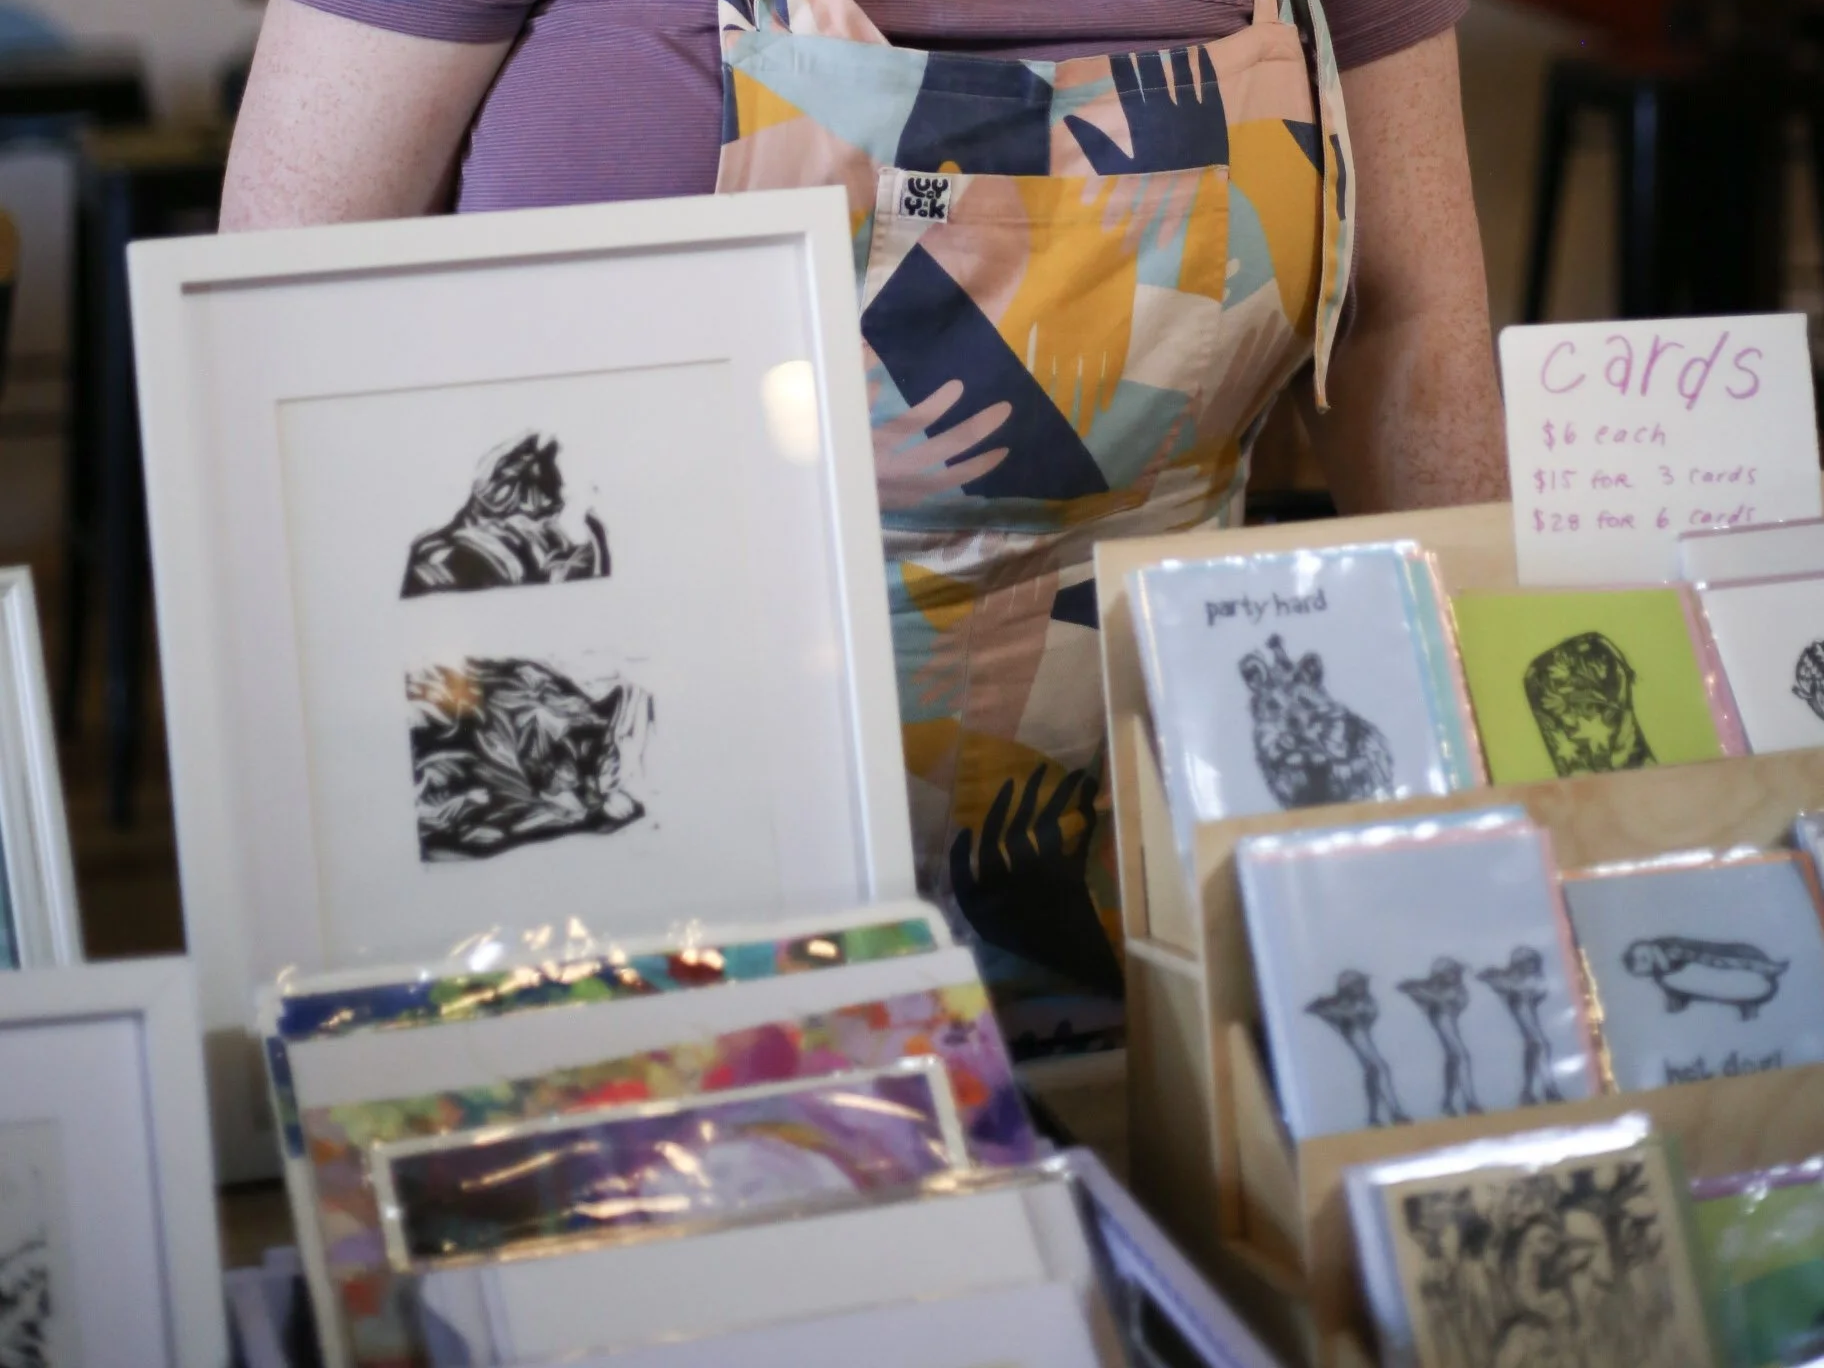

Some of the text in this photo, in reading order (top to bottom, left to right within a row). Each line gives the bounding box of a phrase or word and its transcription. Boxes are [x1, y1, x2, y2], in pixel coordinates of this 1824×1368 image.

[1542, 418, 1666, 451] $6 each
[1533, 469, 1577, 493] $15
[1658, 465, 1675, 485] 3
[1689, 466, 1757, 485] cards
[1532, 508, 1580, 534] $28
[1656, 507, 1670, 529] 6
[1689, 504, 1756, 525] cards
[1205, 588, 1328, 626] party hard
